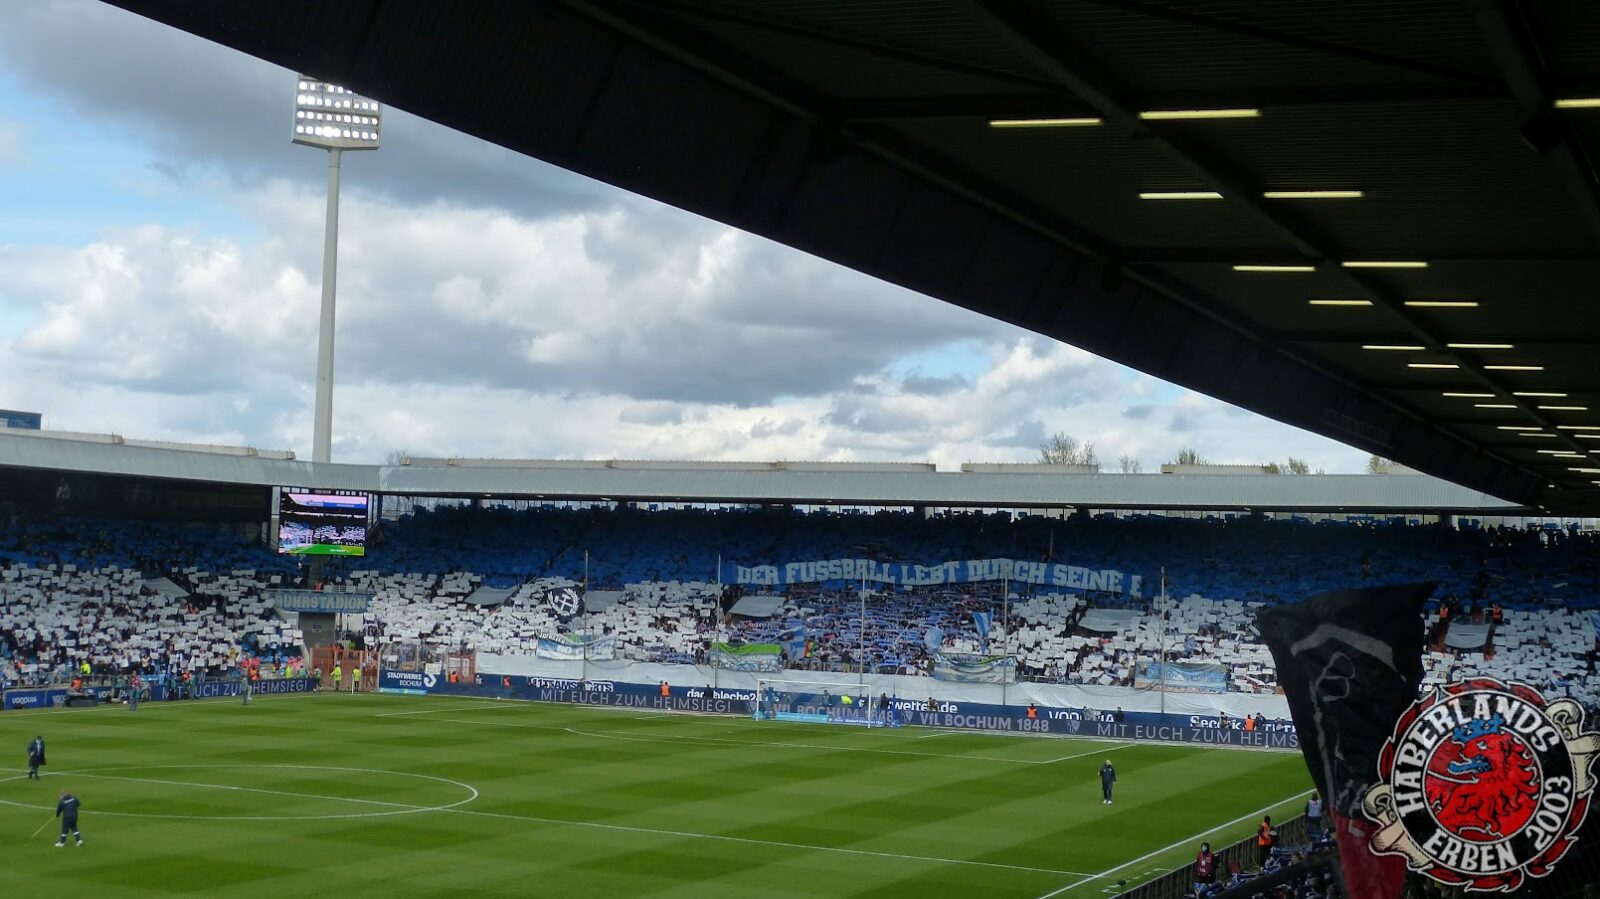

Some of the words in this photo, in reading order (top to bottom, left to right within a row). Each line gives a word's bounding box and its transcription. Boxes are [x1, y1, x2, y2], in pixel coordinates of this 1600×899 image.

[737, 565, 779, 584] DER
[785, 559, 895, 584] FUSSBALL
[901, 561, 960, 585] LEBT
[967, 558, 1047, 584] DURCH
[1053, 564, 1123, 592] SEINE
[275, 592, 367, 609] RUHRSTADION
[387, 672, 422, 680] STADTWERKE
[162, 687, 183, 699] MT
[194, 685, 219, 697] UCH
[252, 680, 307, 693] HEIMSIEG!
[541, 689, 564, 701] MIT
[571, 691, 609, 704] EUCH
[615, 694, 647, 706] ZUM
[653, 696, 731, 712] HEIMSIEG!
[920, 712, 940, 725] VfL
[944, 714, 1011, 730] BOCHUM
[1017, 719, 1049, 732] 1848
[1097, 723, 1127, 737] MIT
[1136, 725, 1183, 740] EUCH
[1191, 729, 1231, 743] ZUM
[1240, 732, 1298, 748] HEIMS
